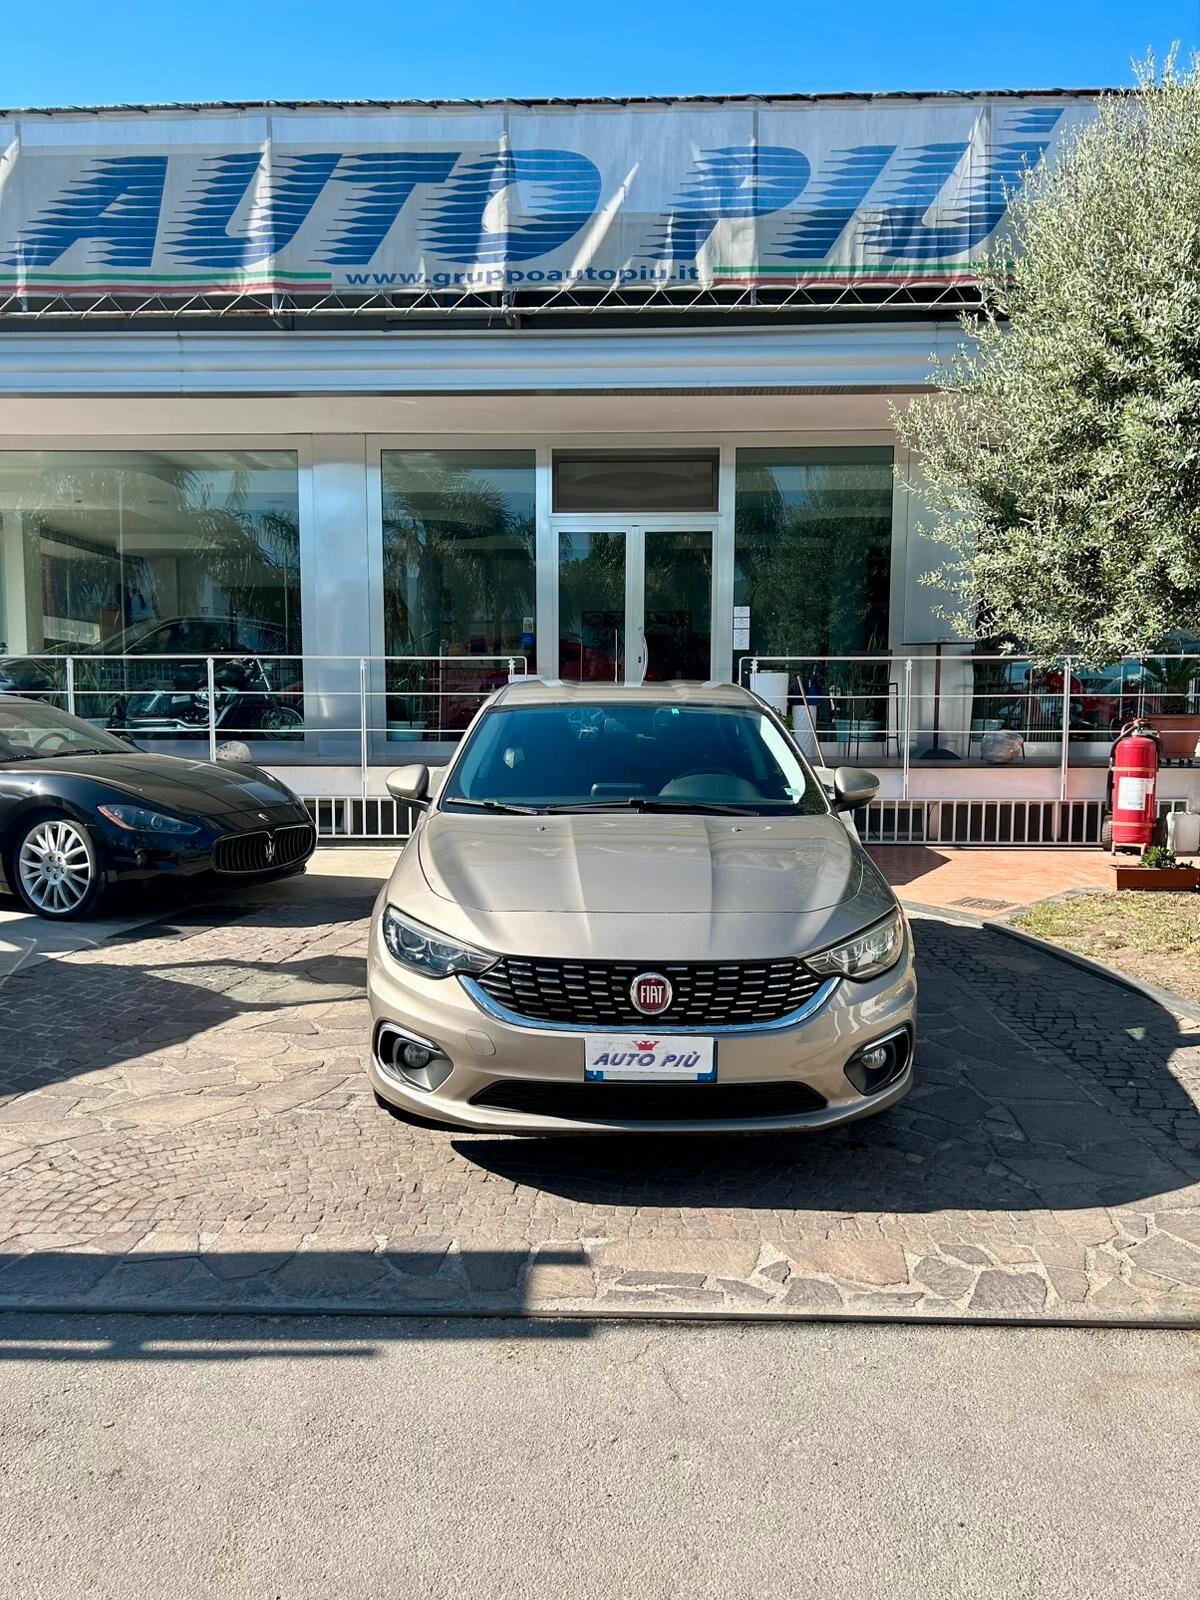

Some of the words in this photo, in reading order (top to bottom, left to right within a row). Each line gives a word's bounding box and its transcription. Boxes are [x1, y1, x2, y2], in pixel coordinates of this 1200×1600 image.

[0, 149, 602, 267] AUTO
[345, 264, 700, 287] www.gruppoautopiu.it
[640, 985, 664, 1004] FIAT
[593, 1053, 655, 1067] AUTO
